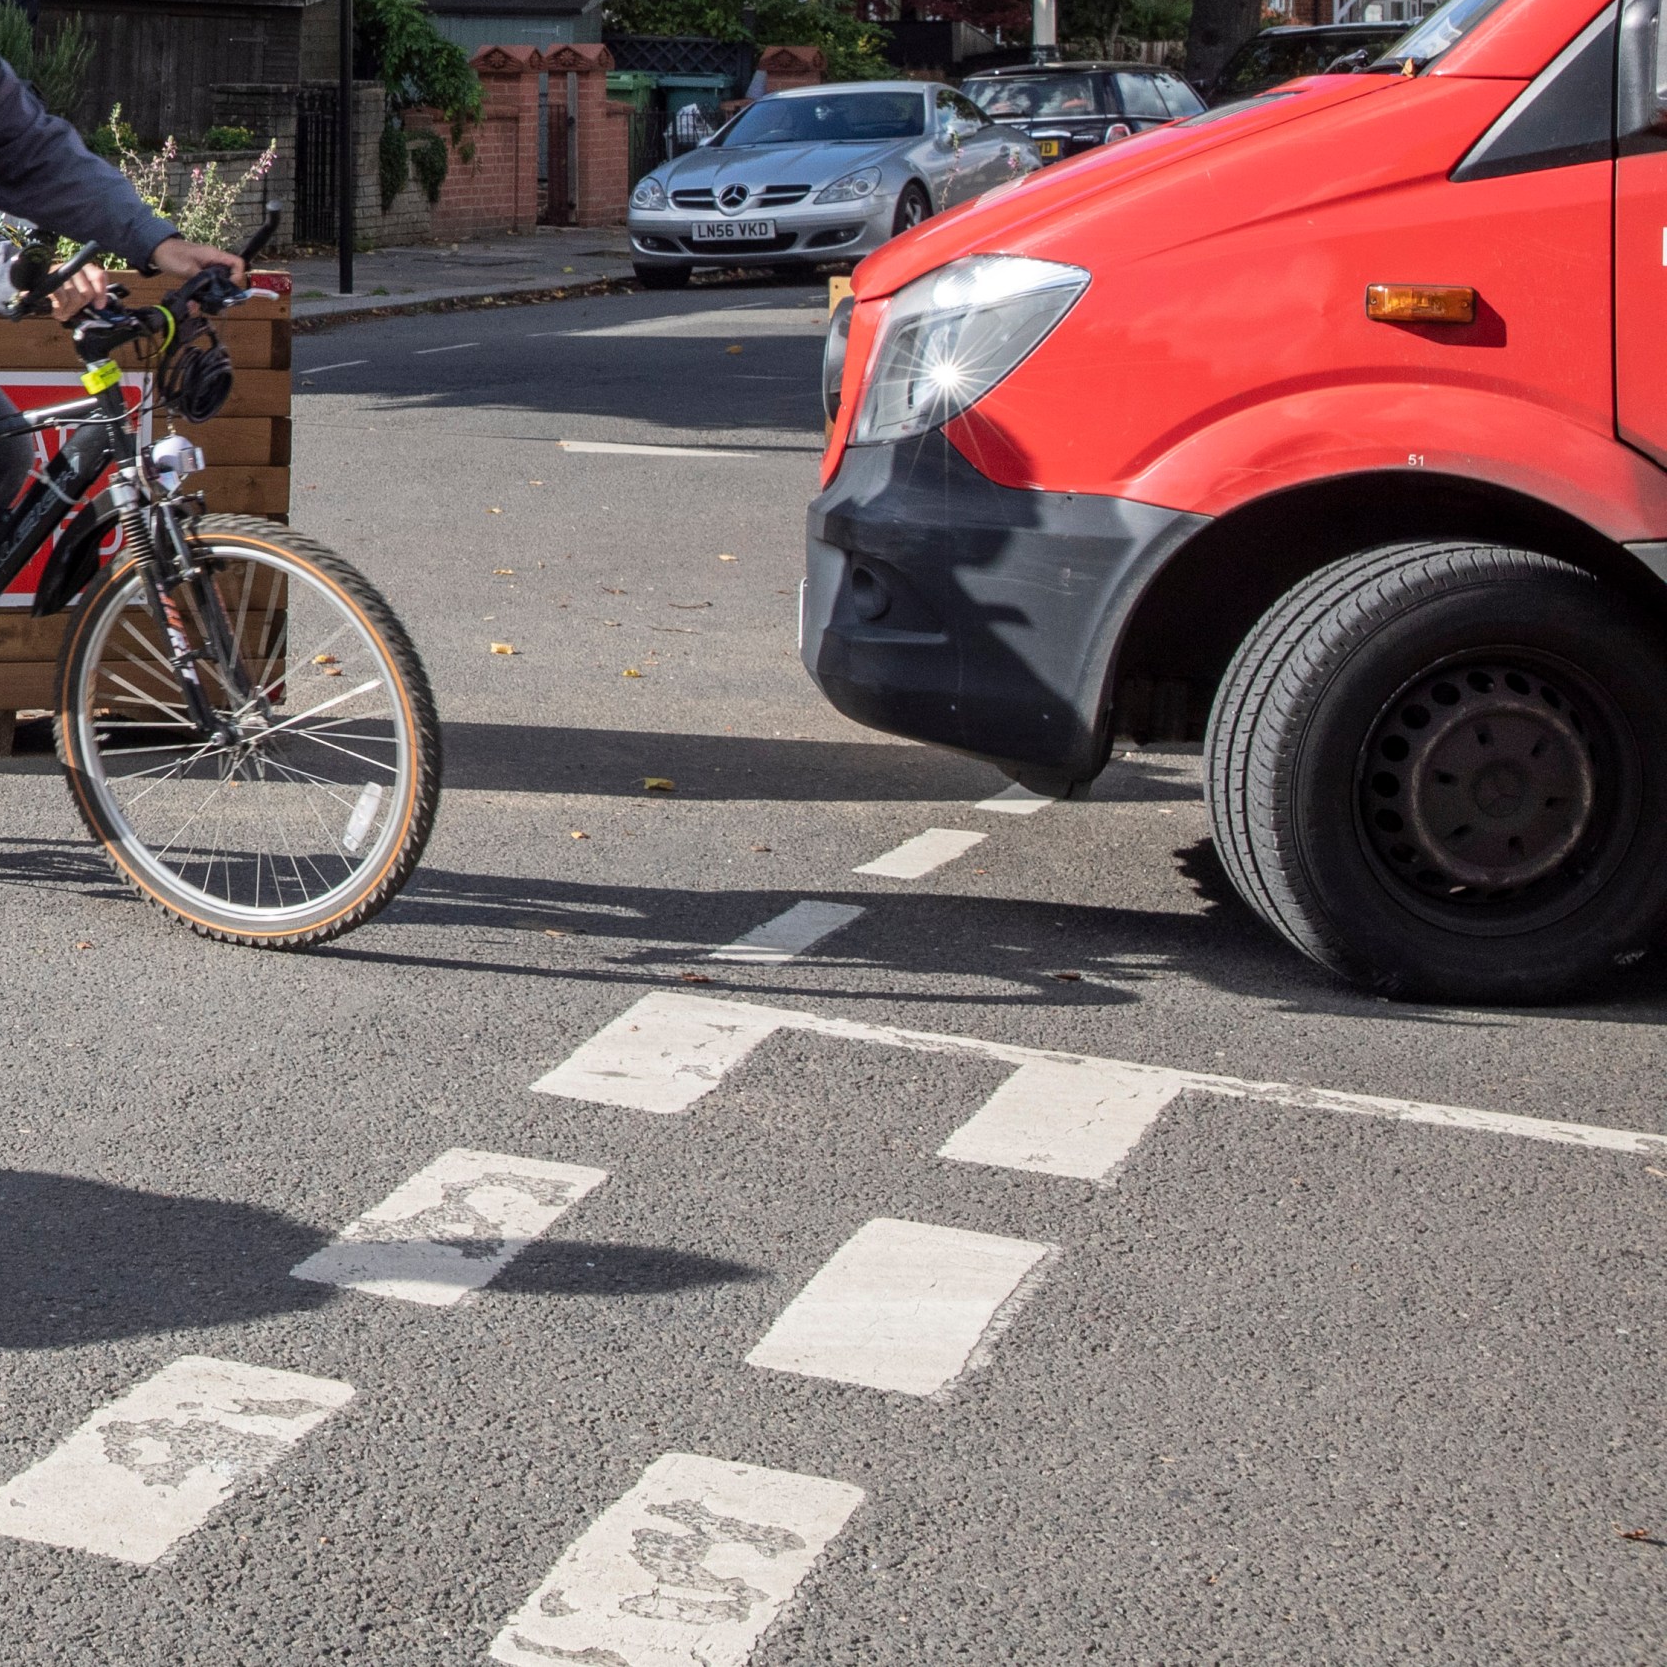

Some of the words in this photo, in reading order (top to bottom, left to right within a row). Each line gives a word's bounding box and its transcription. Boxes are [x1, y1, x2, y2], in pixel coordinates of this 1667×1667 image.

[698, 223, 734, 238] LN56
[738, 222, 768, 237] VKD
[1408, 453, 1424, 467] 51
